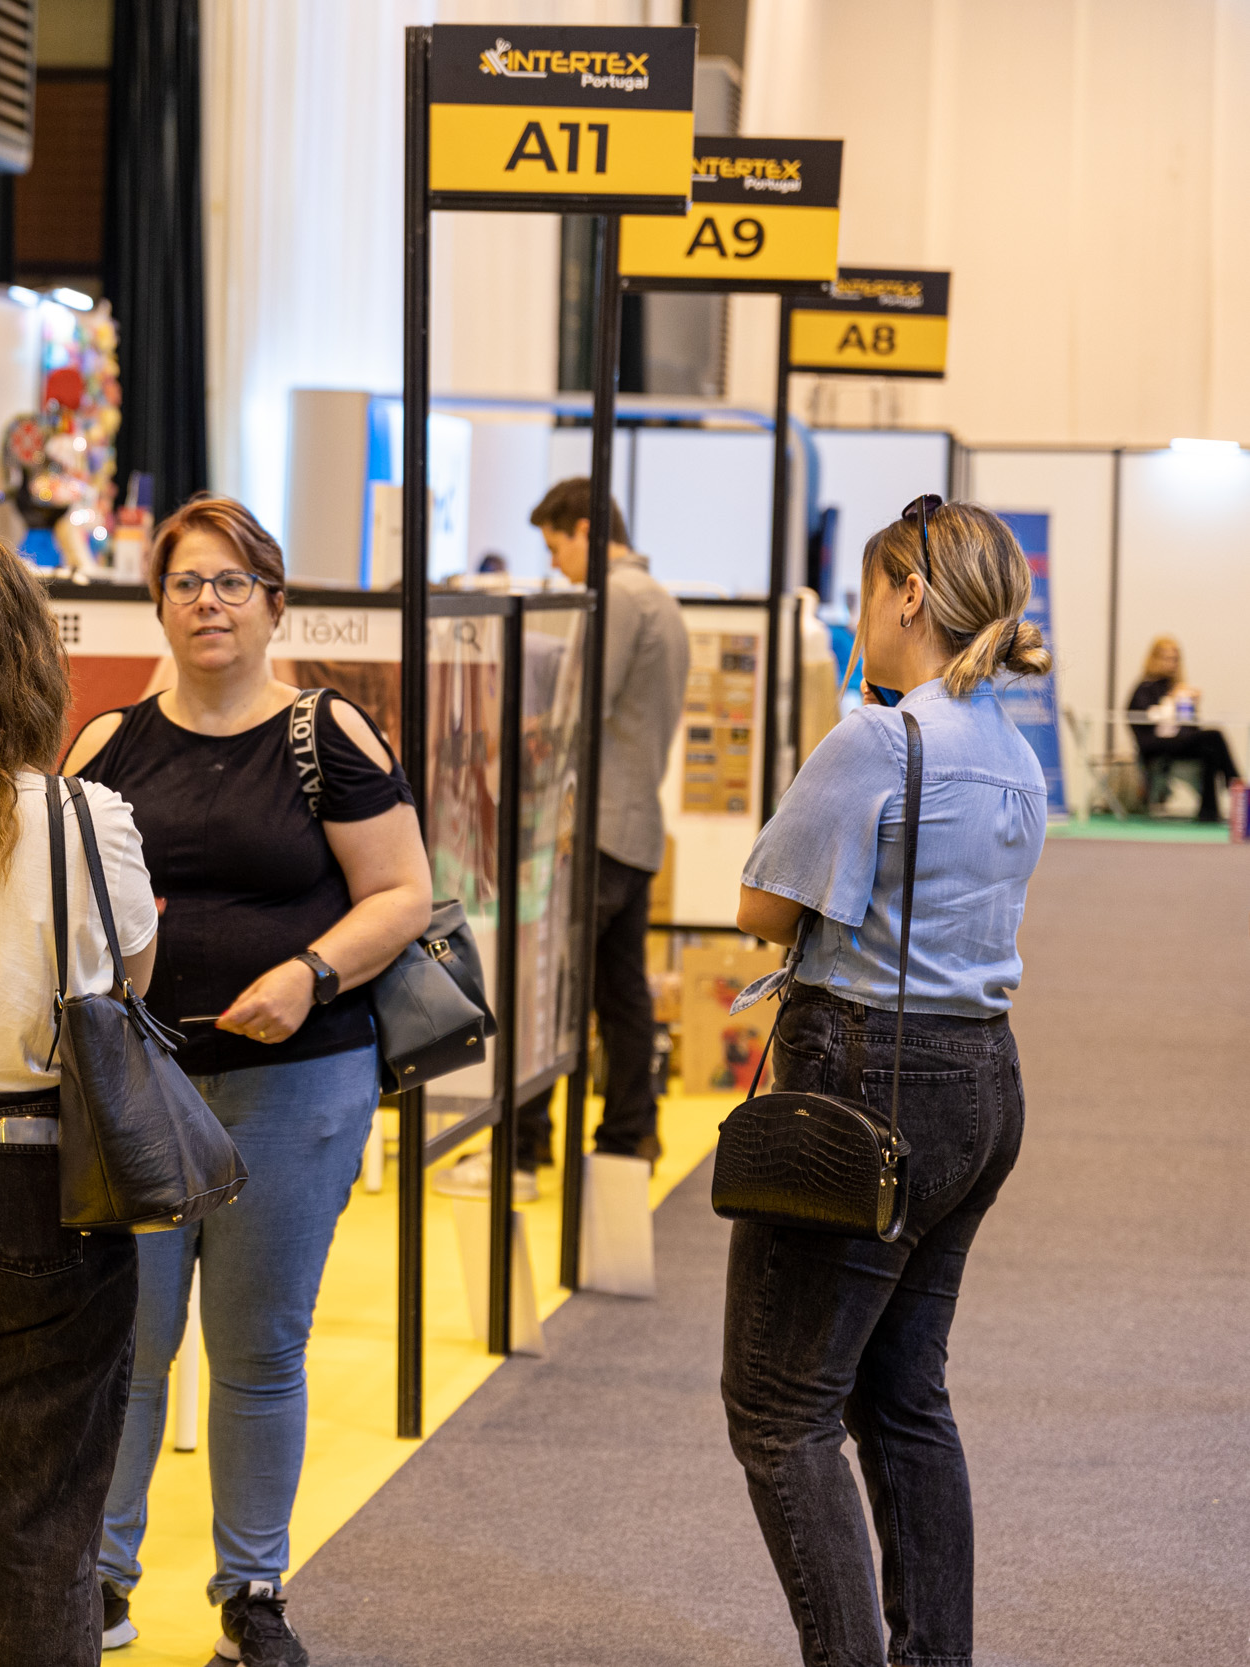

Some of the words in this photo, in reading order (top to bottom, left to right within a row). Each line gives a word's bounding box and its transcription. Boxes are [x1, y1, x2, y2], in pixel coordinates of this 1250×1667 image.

[506, 49, 649, 76] INTERTEX
[581, 73, 648, 91] Portugal
[504, 120, 609, 175] A11
[692, 156, 802, 180] NTERTEX
[686, 216, 765, 259] A9
[836, 322, 897, 356] A8
[302, 612, 368, 645] têxtil
[293, 694, 317, 755] LOLA
